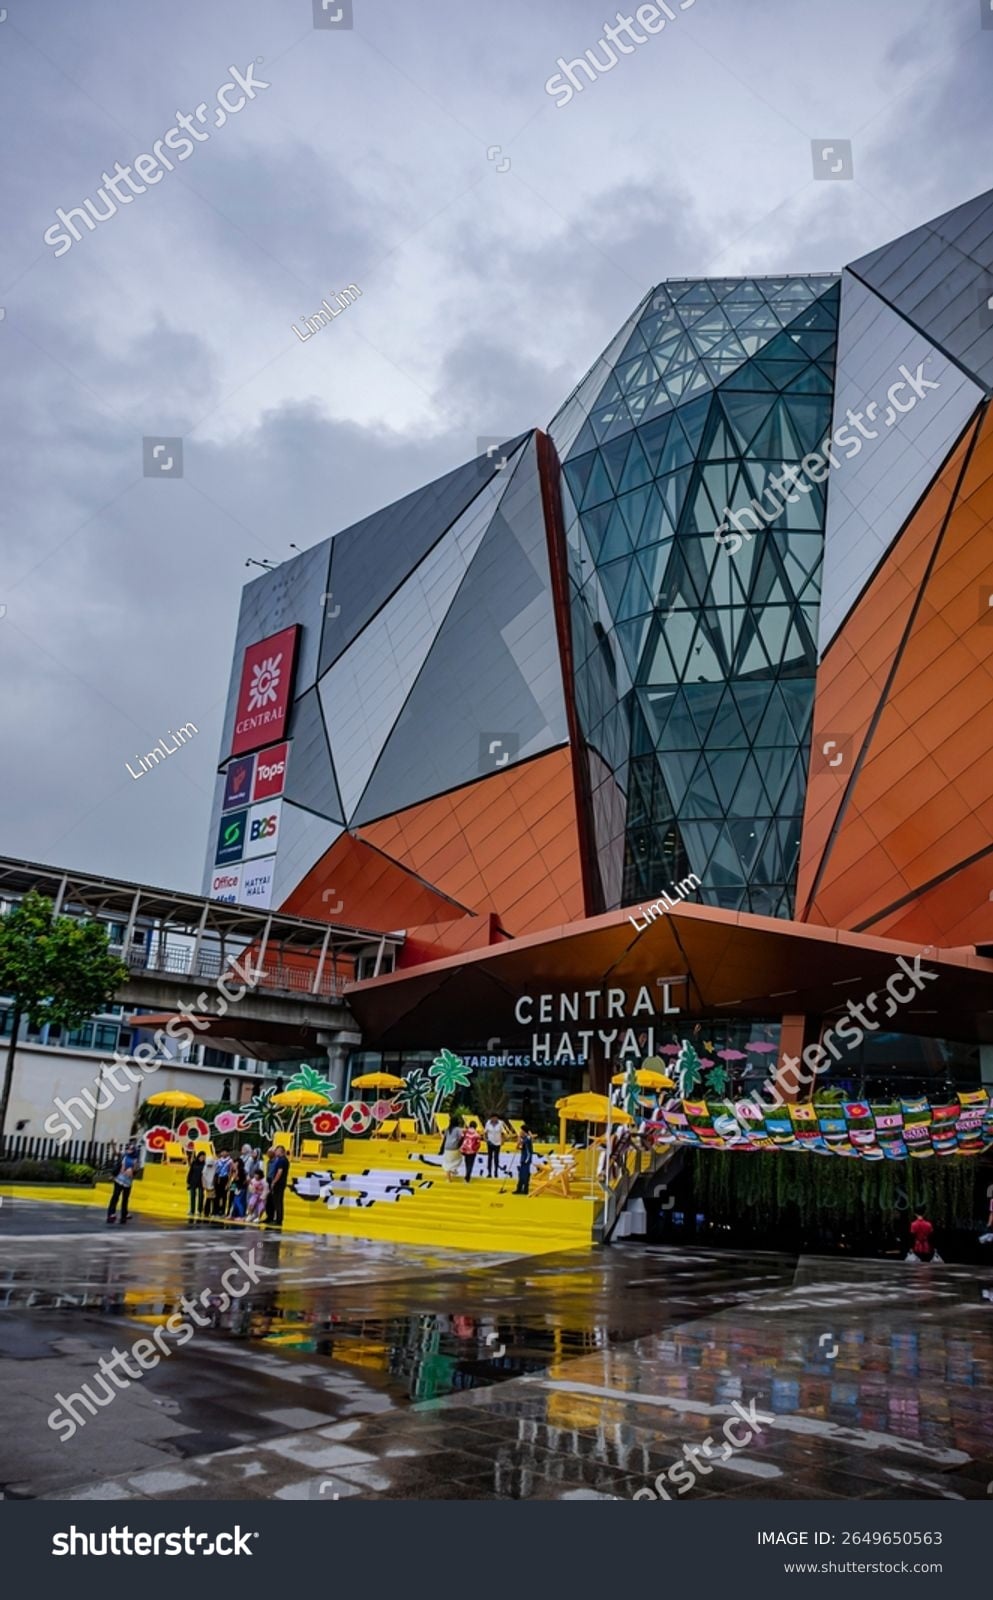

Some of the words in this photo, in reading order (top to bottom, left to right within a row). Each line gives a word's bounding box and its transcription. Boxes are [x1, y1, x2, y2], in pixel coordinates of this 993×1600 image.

[236, 706, 285, 734] CENTRAL
[257, 761, 285, 781] Tops
[249, 814, 277, 842] B2S
[213, 875, 239, 890] Office
[514, 983, 681, 1025] CENTRAL
[531, 1026, 655, 1062] HATYAI
[460, 1054, 530, 1068] TARBUCKS
